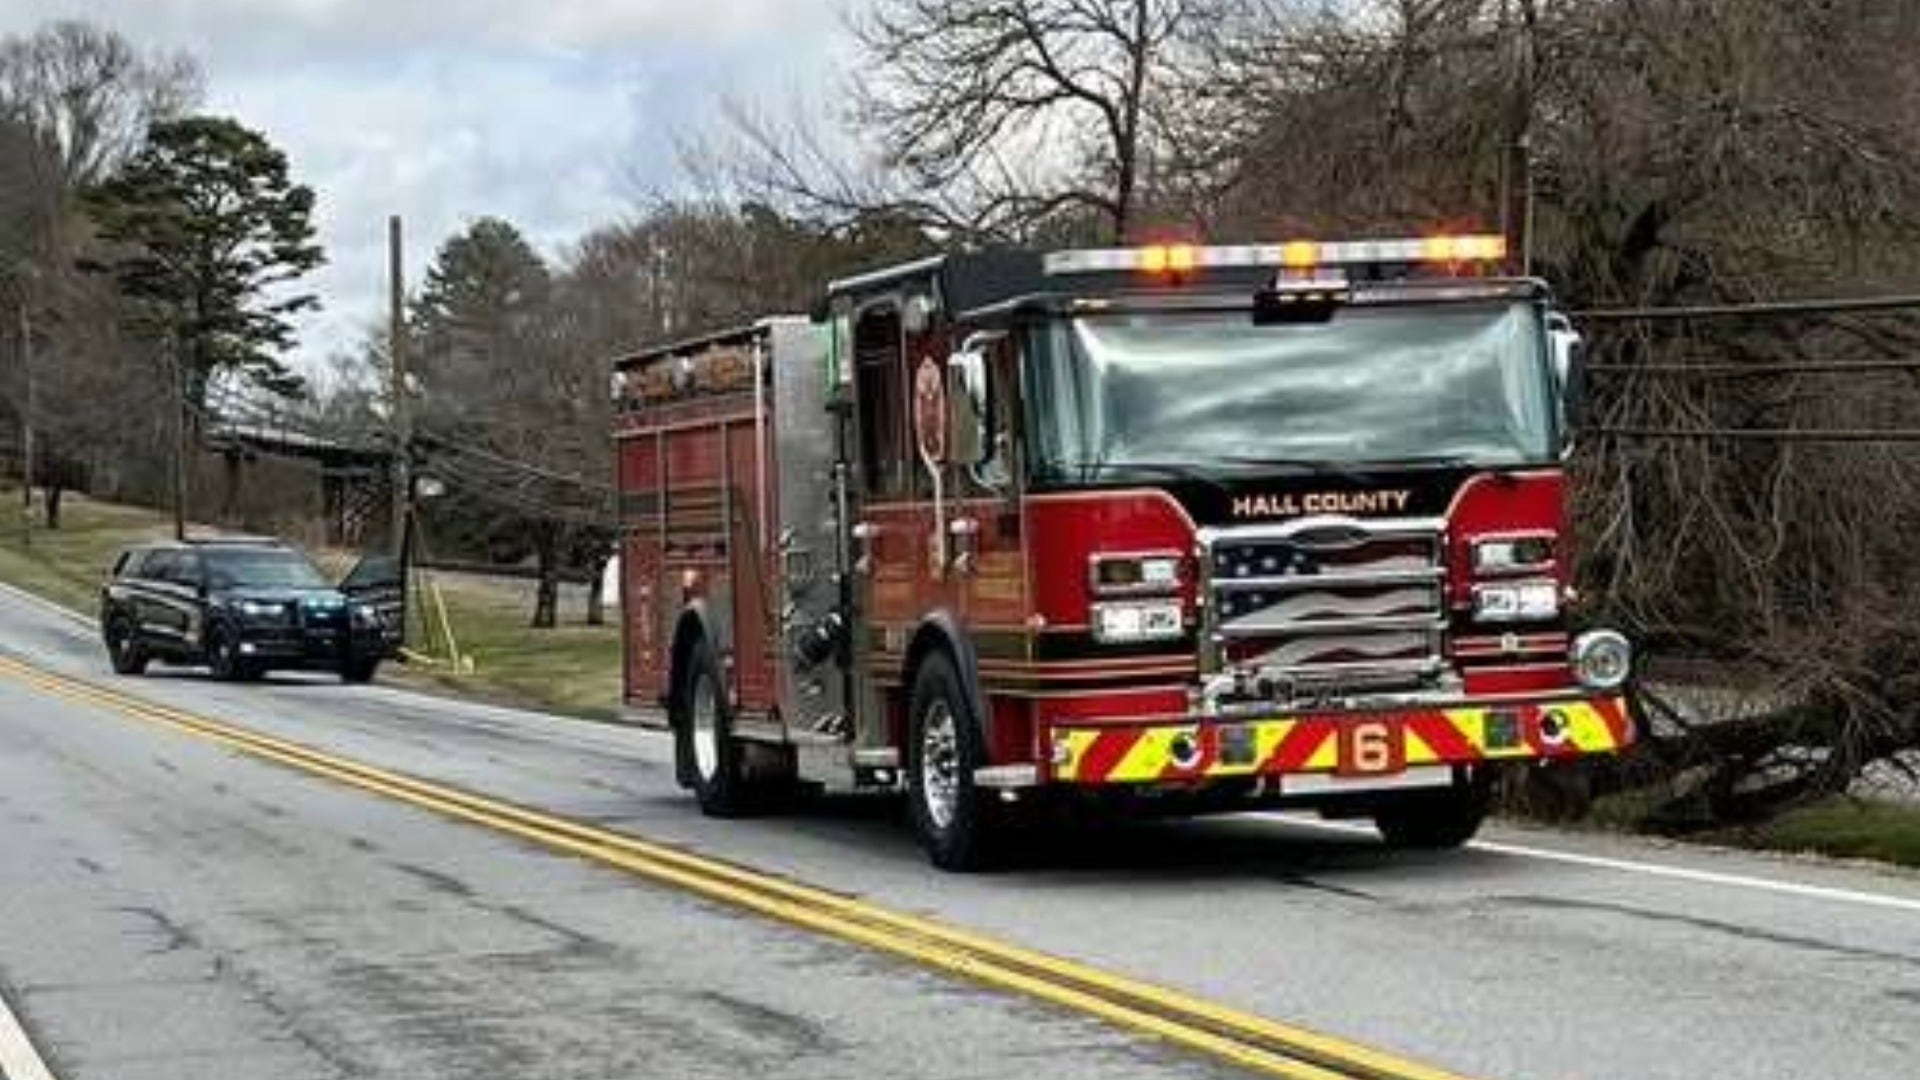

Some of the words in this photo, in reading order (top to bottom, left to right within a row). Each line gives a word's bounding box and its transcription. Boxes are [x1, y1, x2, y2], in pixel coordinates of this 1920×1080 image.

[1233, 494, 1299, 516] HALL
[1303, 489, 1408, 512] COUNTY
[1353, 723, 1389, 771] 6
